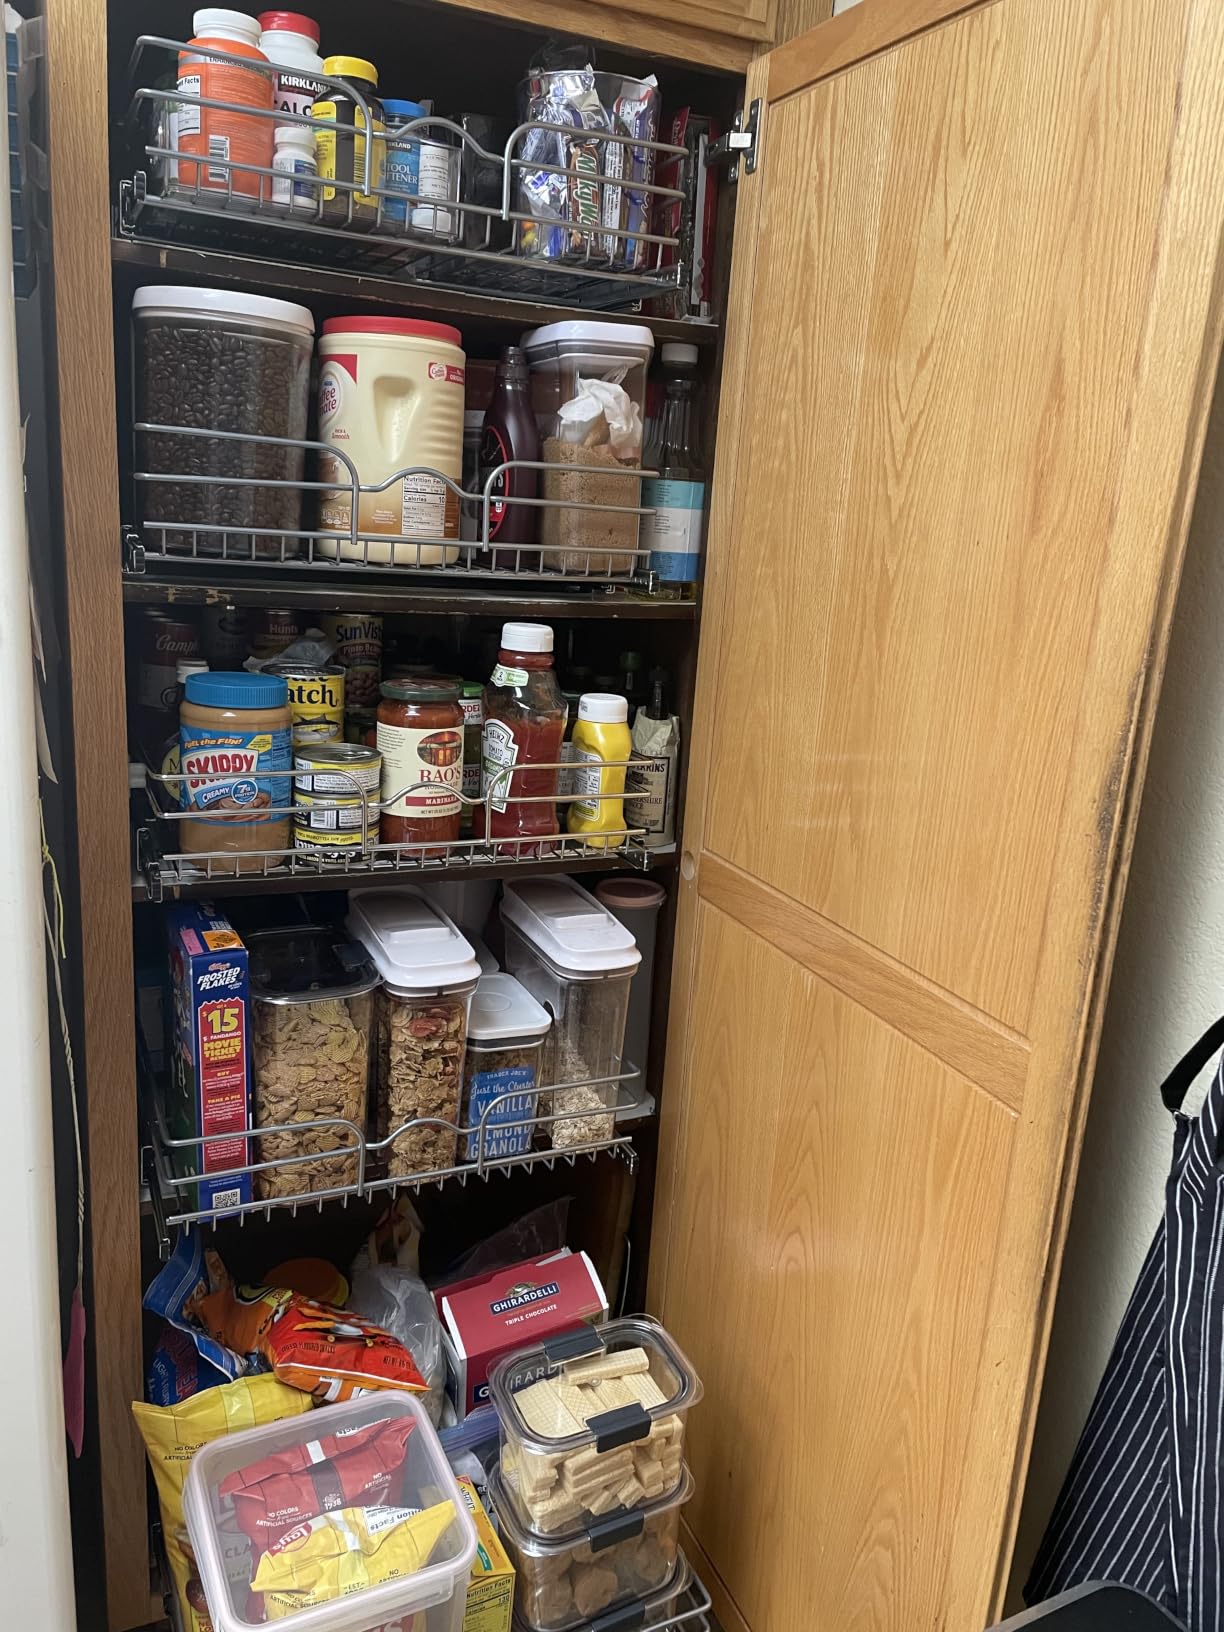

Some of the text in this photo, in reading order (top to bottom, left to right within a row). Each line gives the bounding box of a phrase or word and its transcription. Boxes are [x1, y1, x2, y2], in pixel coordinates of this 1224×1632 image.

[202, 786, 230, 803] CREAMY
[197, 967, 241, 984] FROSTED
[200, 974, 237, 991] FLAKES
[210, 1031, 241, 1040] FANDANGO
[204, 1038, 241, 1050] MOVIE
[204, 1046, 241, 1058] TICKET
[493, 1083, 506, 1093] the
[493, 1284, 557, 1313] GHIRARDELLI
[505, 1304, 558, 1326] TRIPLE CHOCOLATE
[373, 1472, 383, 1480] NO
[256, 1511, 313, 1527] ARTIFICIAL SOURCES
[276, 1506, 299, 1517] COLORS
[370, 1516, 395, 1531] Facts
[389, 1568, 399, 1576] NO
[466, 1578, 511, 1599] Nutrition Facts
[270, 1594, 299, 1609] ARTIFICIAL
